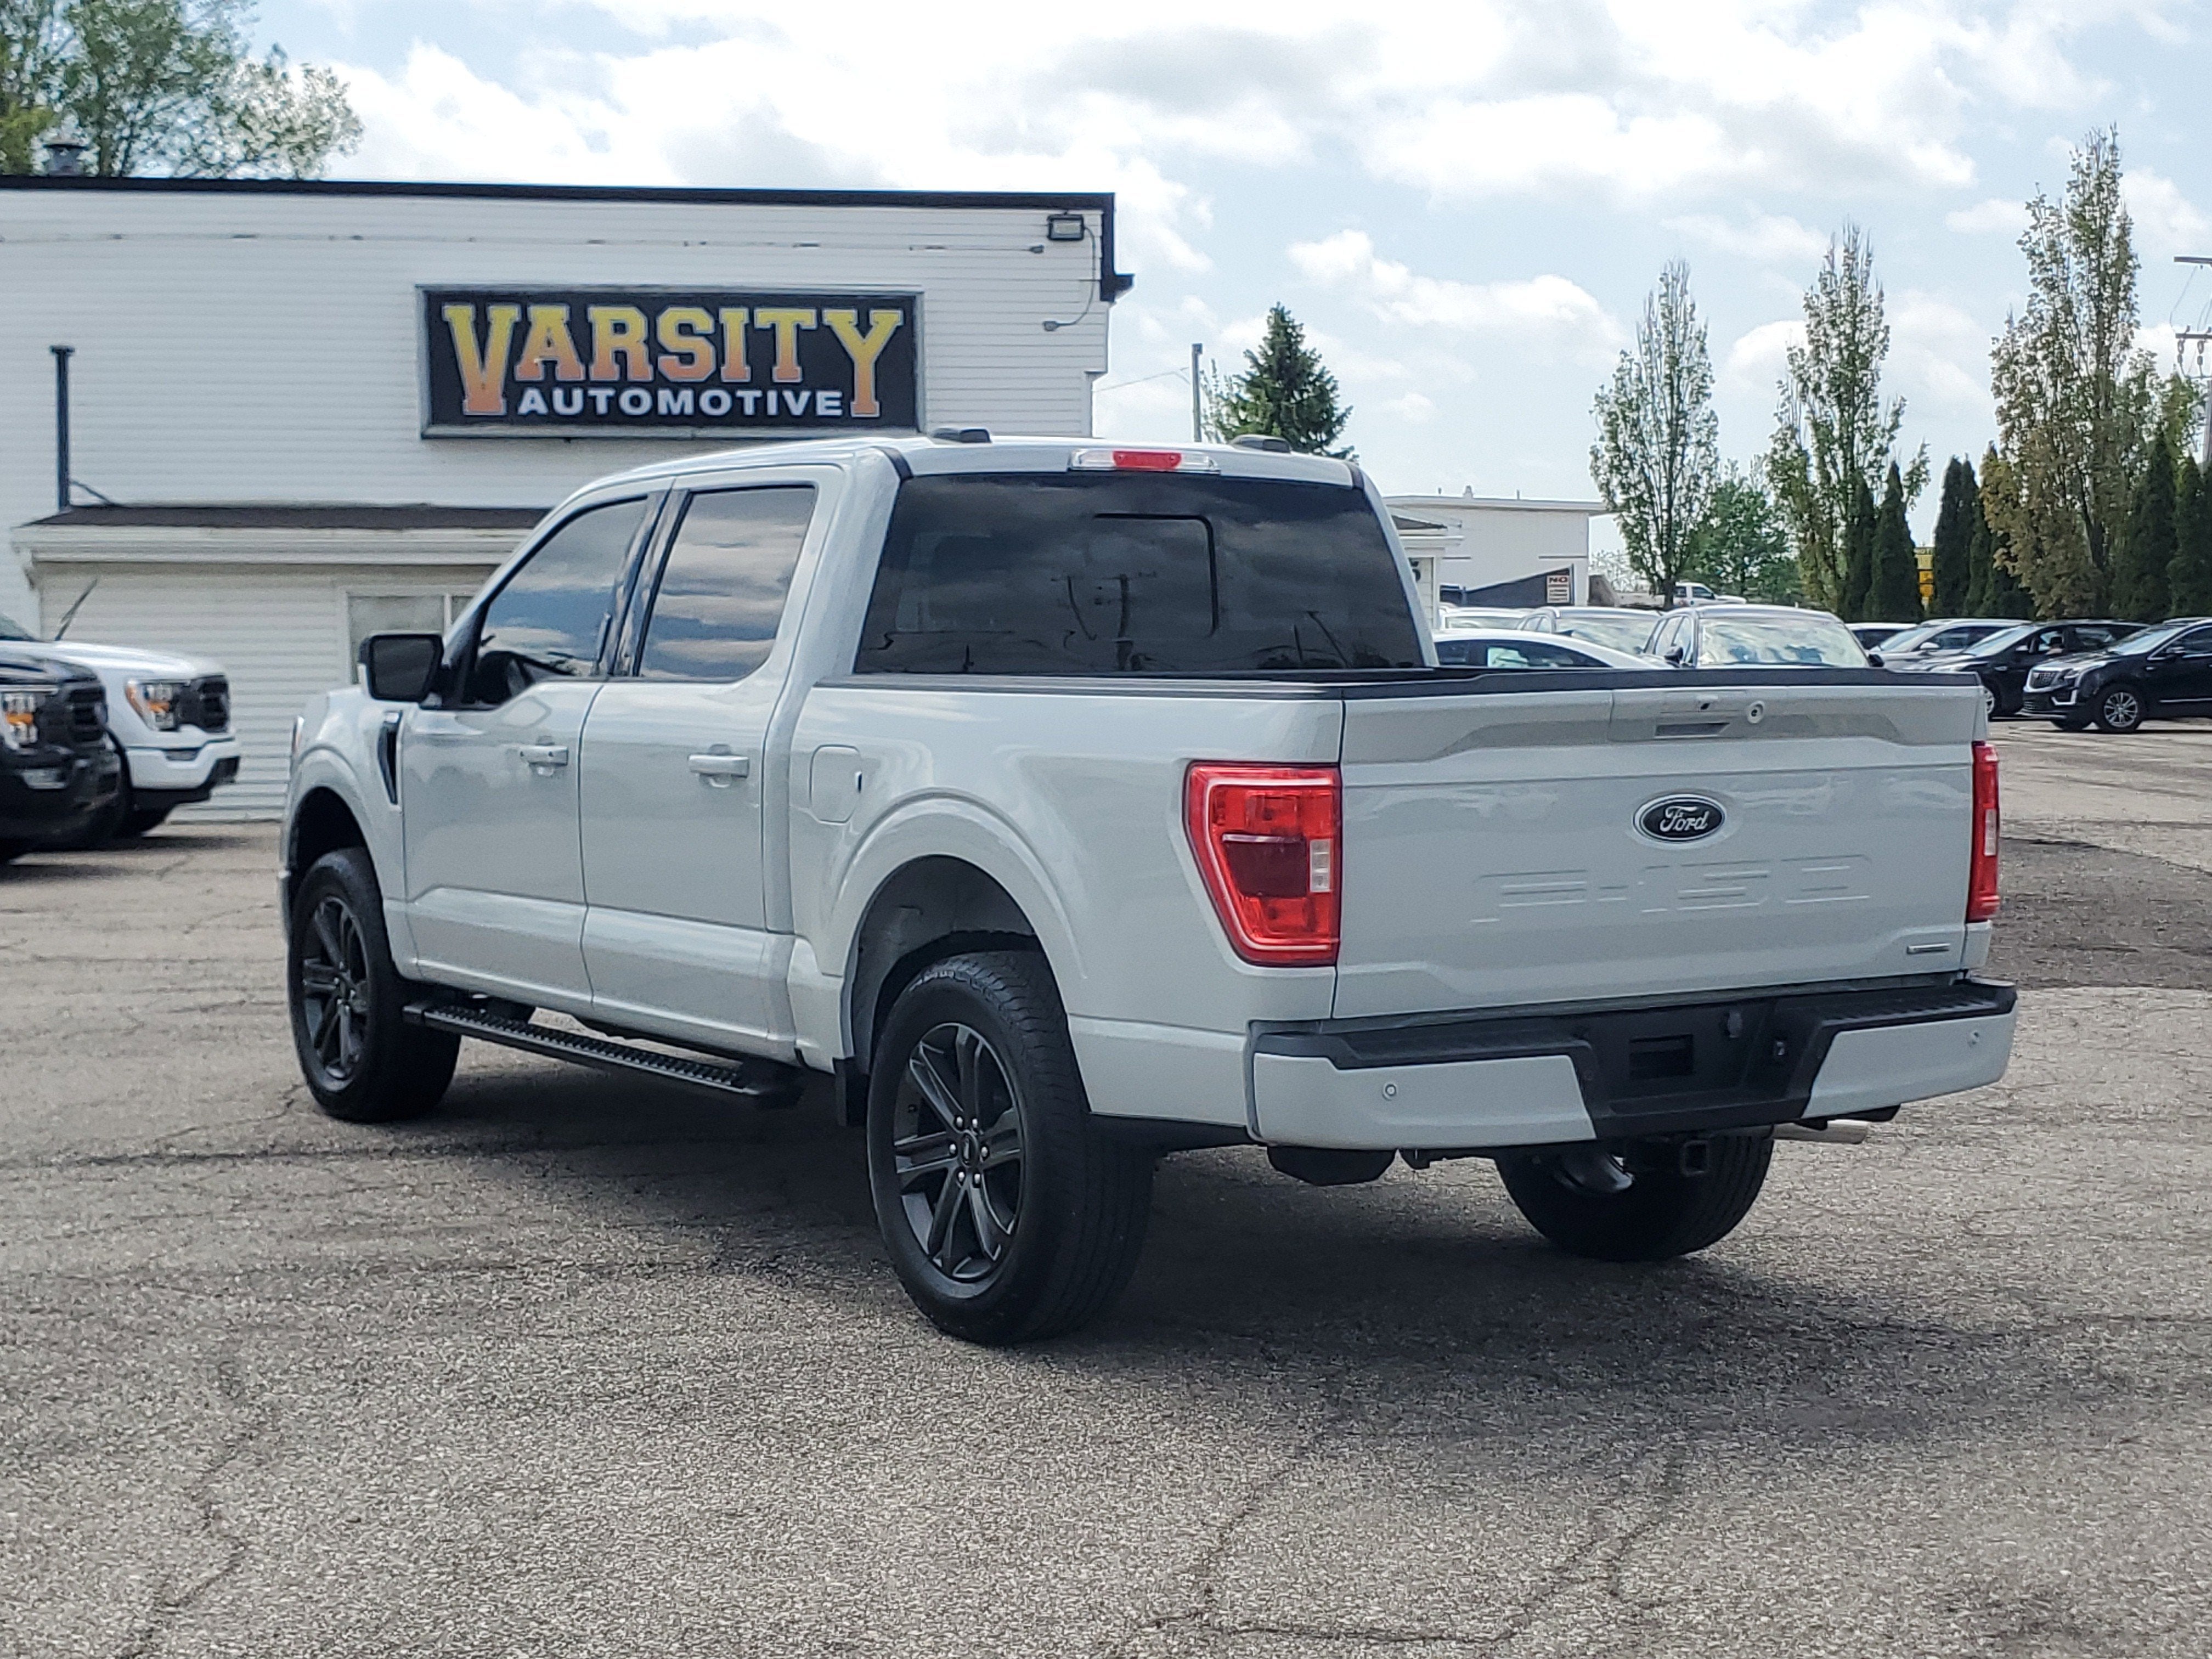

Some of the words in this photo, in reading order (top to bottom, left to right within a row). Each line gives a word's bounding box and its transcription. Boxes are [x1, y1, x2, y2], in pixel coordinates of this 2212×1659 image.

[442, 304, 903, 418] VARSITY
[517, 388, 843, 416] AUTOMOTIVE
[1660, 805, 1710, 832] Ford
